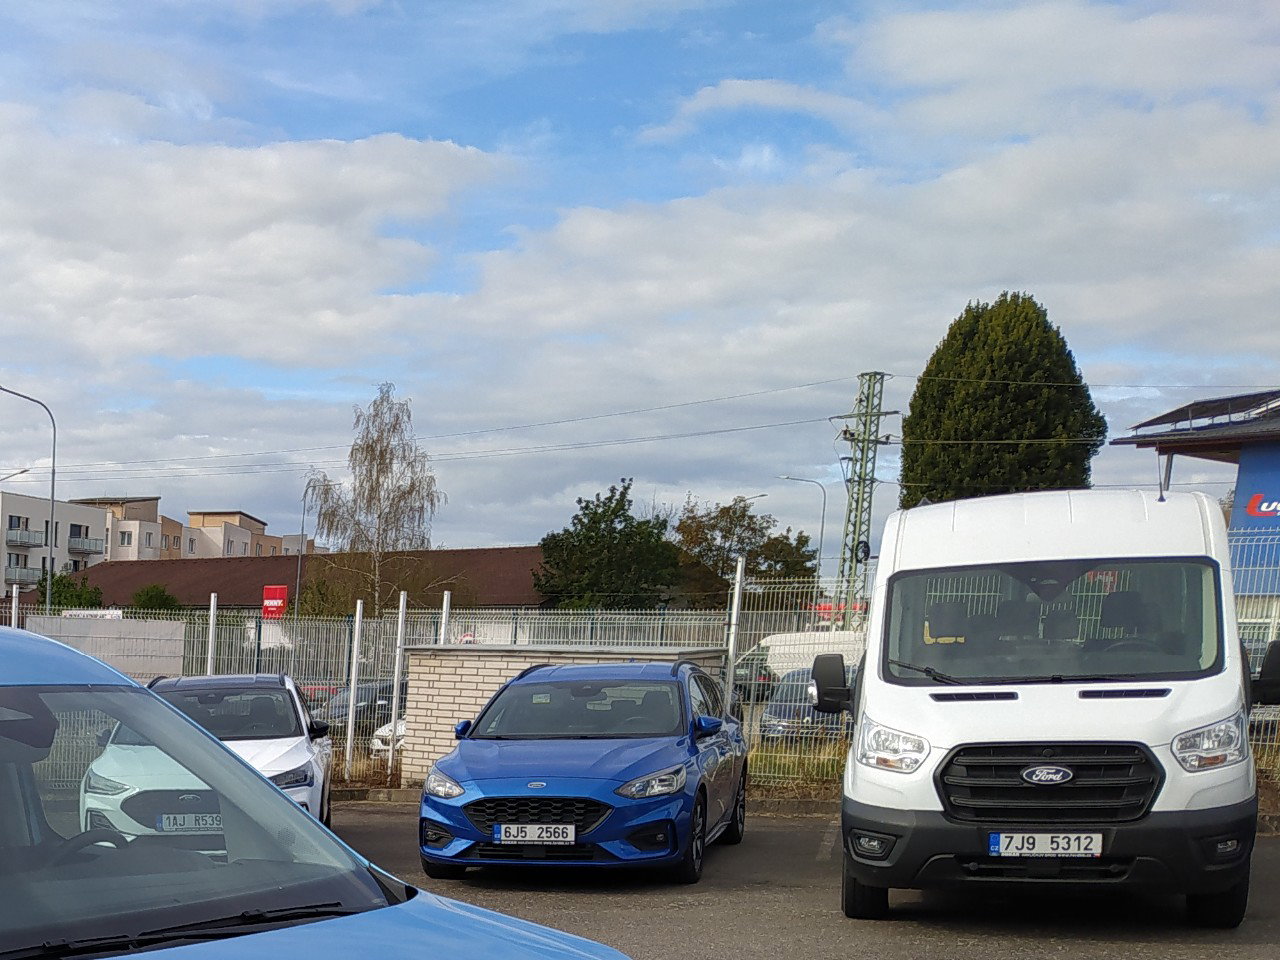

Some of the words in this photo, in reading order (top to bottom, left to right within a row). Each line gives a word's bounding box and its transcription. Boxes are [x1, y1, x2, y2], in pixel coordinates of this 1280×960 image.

[1032, 769, 1064, 781] Ford
[165, 815, 186, 828] 1AJ
[504, 826, 528, 839] 6J5
[537, 826, 569, 839] 2566
[1004, 835, 1036, 851] 7J9
[1050, 835, 1094, 851] 5312
